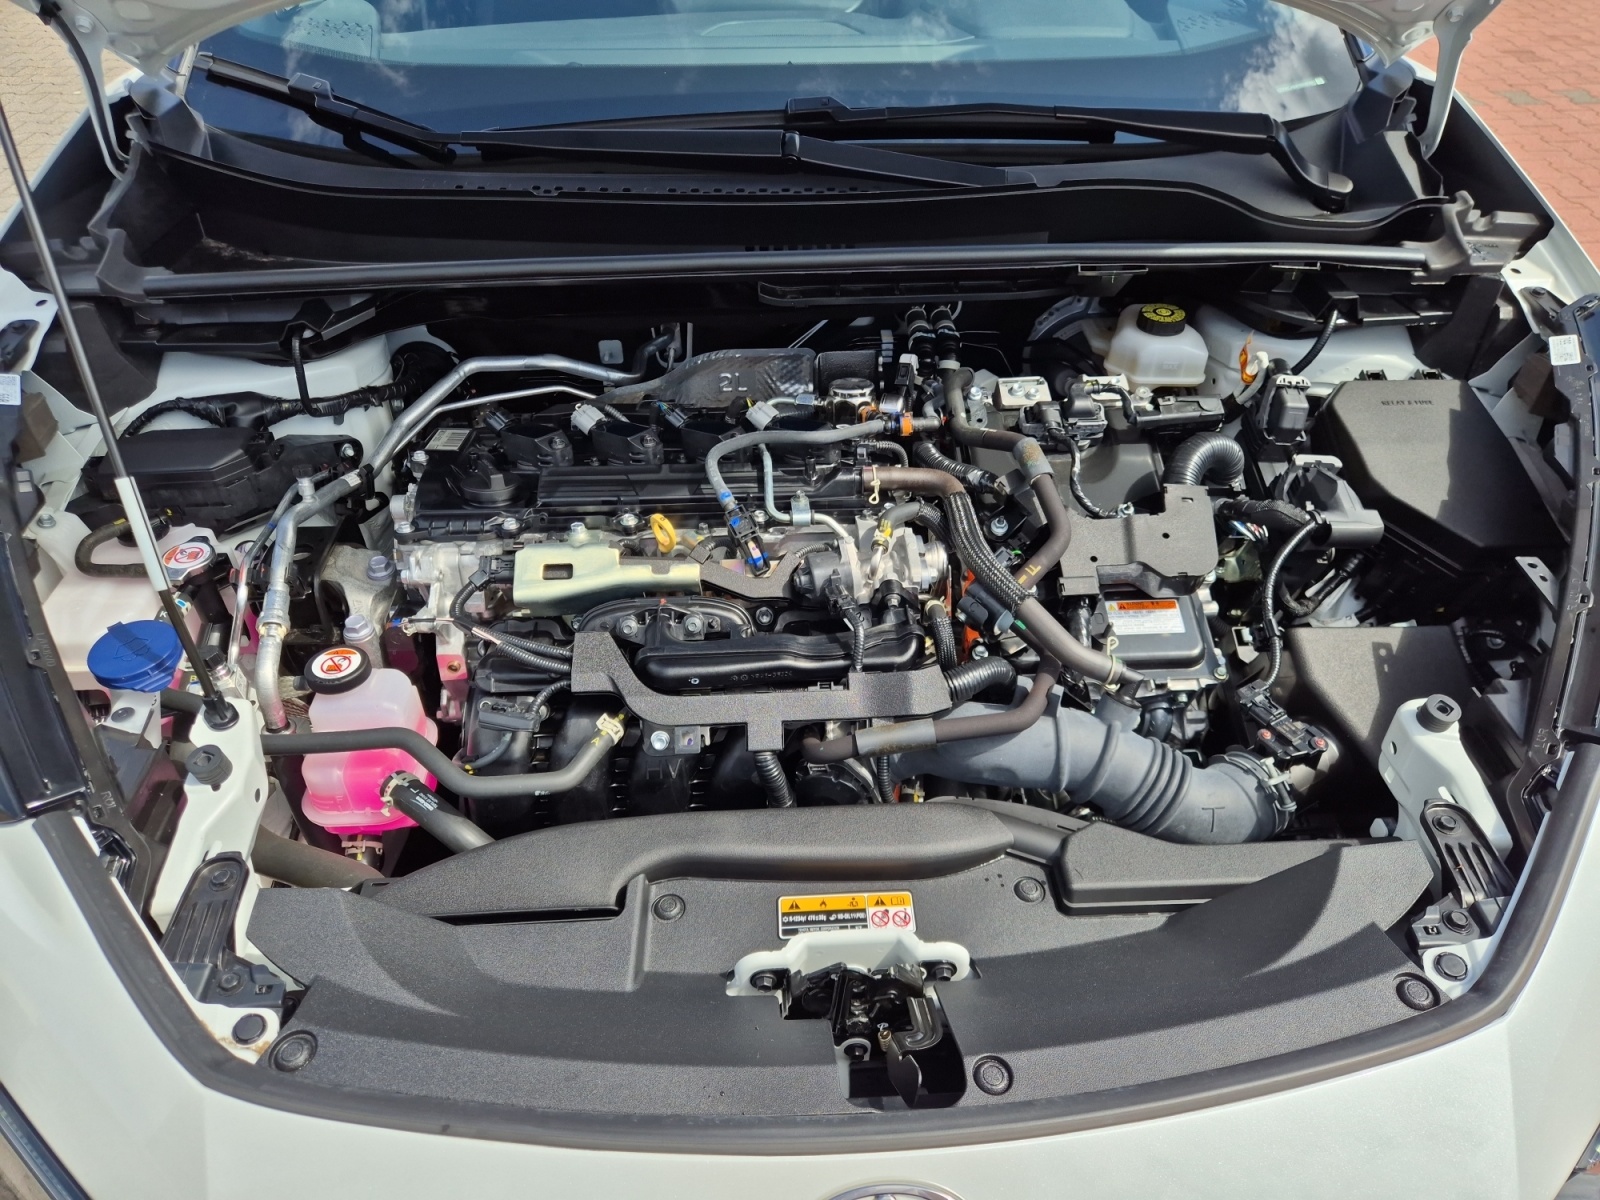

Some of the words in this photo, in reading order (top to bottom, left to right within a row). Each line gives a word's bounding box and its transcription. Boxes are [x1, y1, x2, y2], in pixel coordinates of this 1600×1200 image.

[719, 372, 748, 392] 2L
[646, 758, 682, 780] HV
[1201, 806, 1226, 833] T
